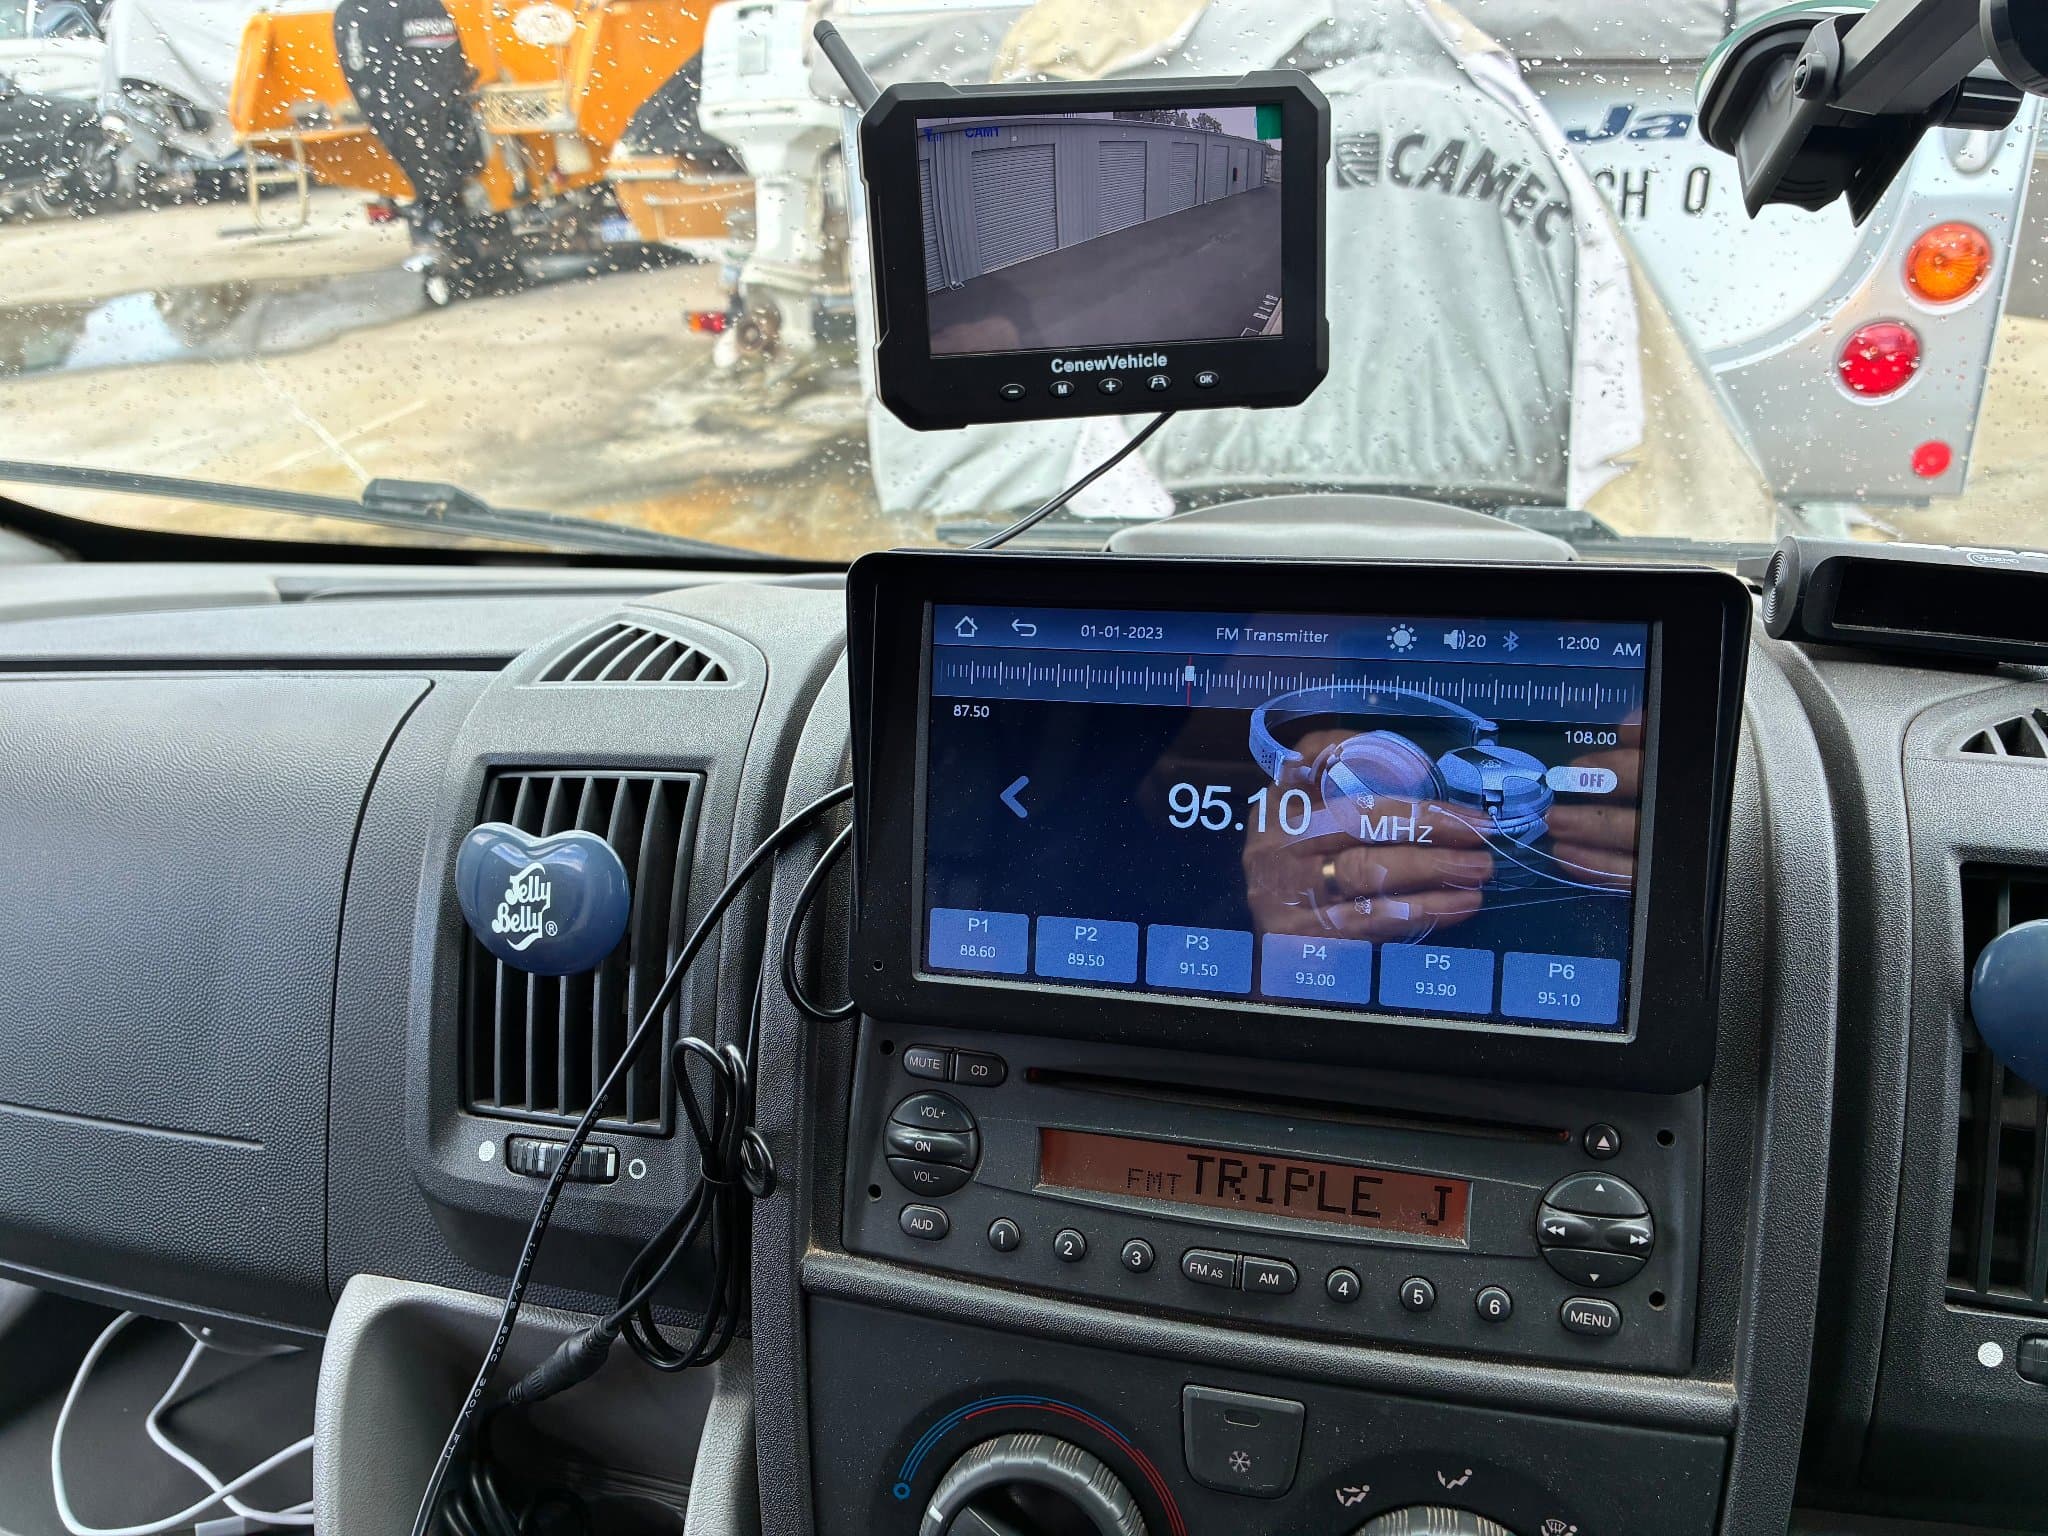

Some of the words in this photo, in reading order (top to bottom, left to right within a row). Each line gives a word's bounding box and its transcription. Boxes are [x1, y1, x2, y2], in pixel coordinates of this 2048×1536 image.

[965, 126, 999, 138] CAM1
[1389, 133, 1571, 246] CAMEC
[1057, 384, 1068, 395] M
[1199, 375, 1213, 384] OK
[1080, 624, 1164, 641] 01-01-2023
[1216, 627, 1240, 641] FM
[1243, 628, 1330, 644] Transmitter
[1466, 634, 1487, 648] 20
[1557, 636, 1600, 651] 12:00
[1612, 643, 1642, 657] AM
[952, 705, 991, 719] 87.50
[1565, 729, 1618, 746] 108.00
[1579, 772, 1605, 788] OFF
[1167, 782, 1313, 836] 95.10
[1359, 813, 1434, 844] MHz
[504, 862, 551, 909] Jelly
[491, 902, 543, 952] Belly
[967, 917, 989, 933] P1
[1074, 925, 1098, 942] P2
[1185, 934, 1210, 951] P3
[1302, 943, 1328, 961] P4
[1424, 953, 1451, 971] P5
[1549, 962, 1576, 980] P6
[959, 944, 997, 959] 88.60
[1067, 952, 1105, 968] 89.50
[1178, 961, 1218, 977] 91.50
[1294, 970, 1336, 987] 93.00
[1414, 981, 1457, 998] 93.90
[1537, 991, 1581, 1008] 95.10
[908, 1055, 942, 1071] MUTE
[970, 1064, 989, 1077] CD
[919, 1105, 947, 1119] VOL+
[914, 1140, 931, 1153] ON
[1126, 1166, 1183, 1197] FMT
[1186, 1153, 1384, 1220] TRIPLE
[1419, 1185, 1453, 1227] J
[910, 1217, 934, 1231] AUD
[998, 1230, 1006, 1246] 1
[1062, 1240, 1074, 1256] 2
[1130, 1250, 1142, 1266] 3
[1188, 1262, 1208, 1277] FM
[1210, 1268, 1224, 1280] AS
[1258, 1272, 1280, 1286] AM
[1337, 1281, 1349, 1296] 4
[1412, 1288, 1424, 1305] 5
[1488, 1299, 1501, 1315] 6
[1569, 1310, 1612, 1328] MENU
